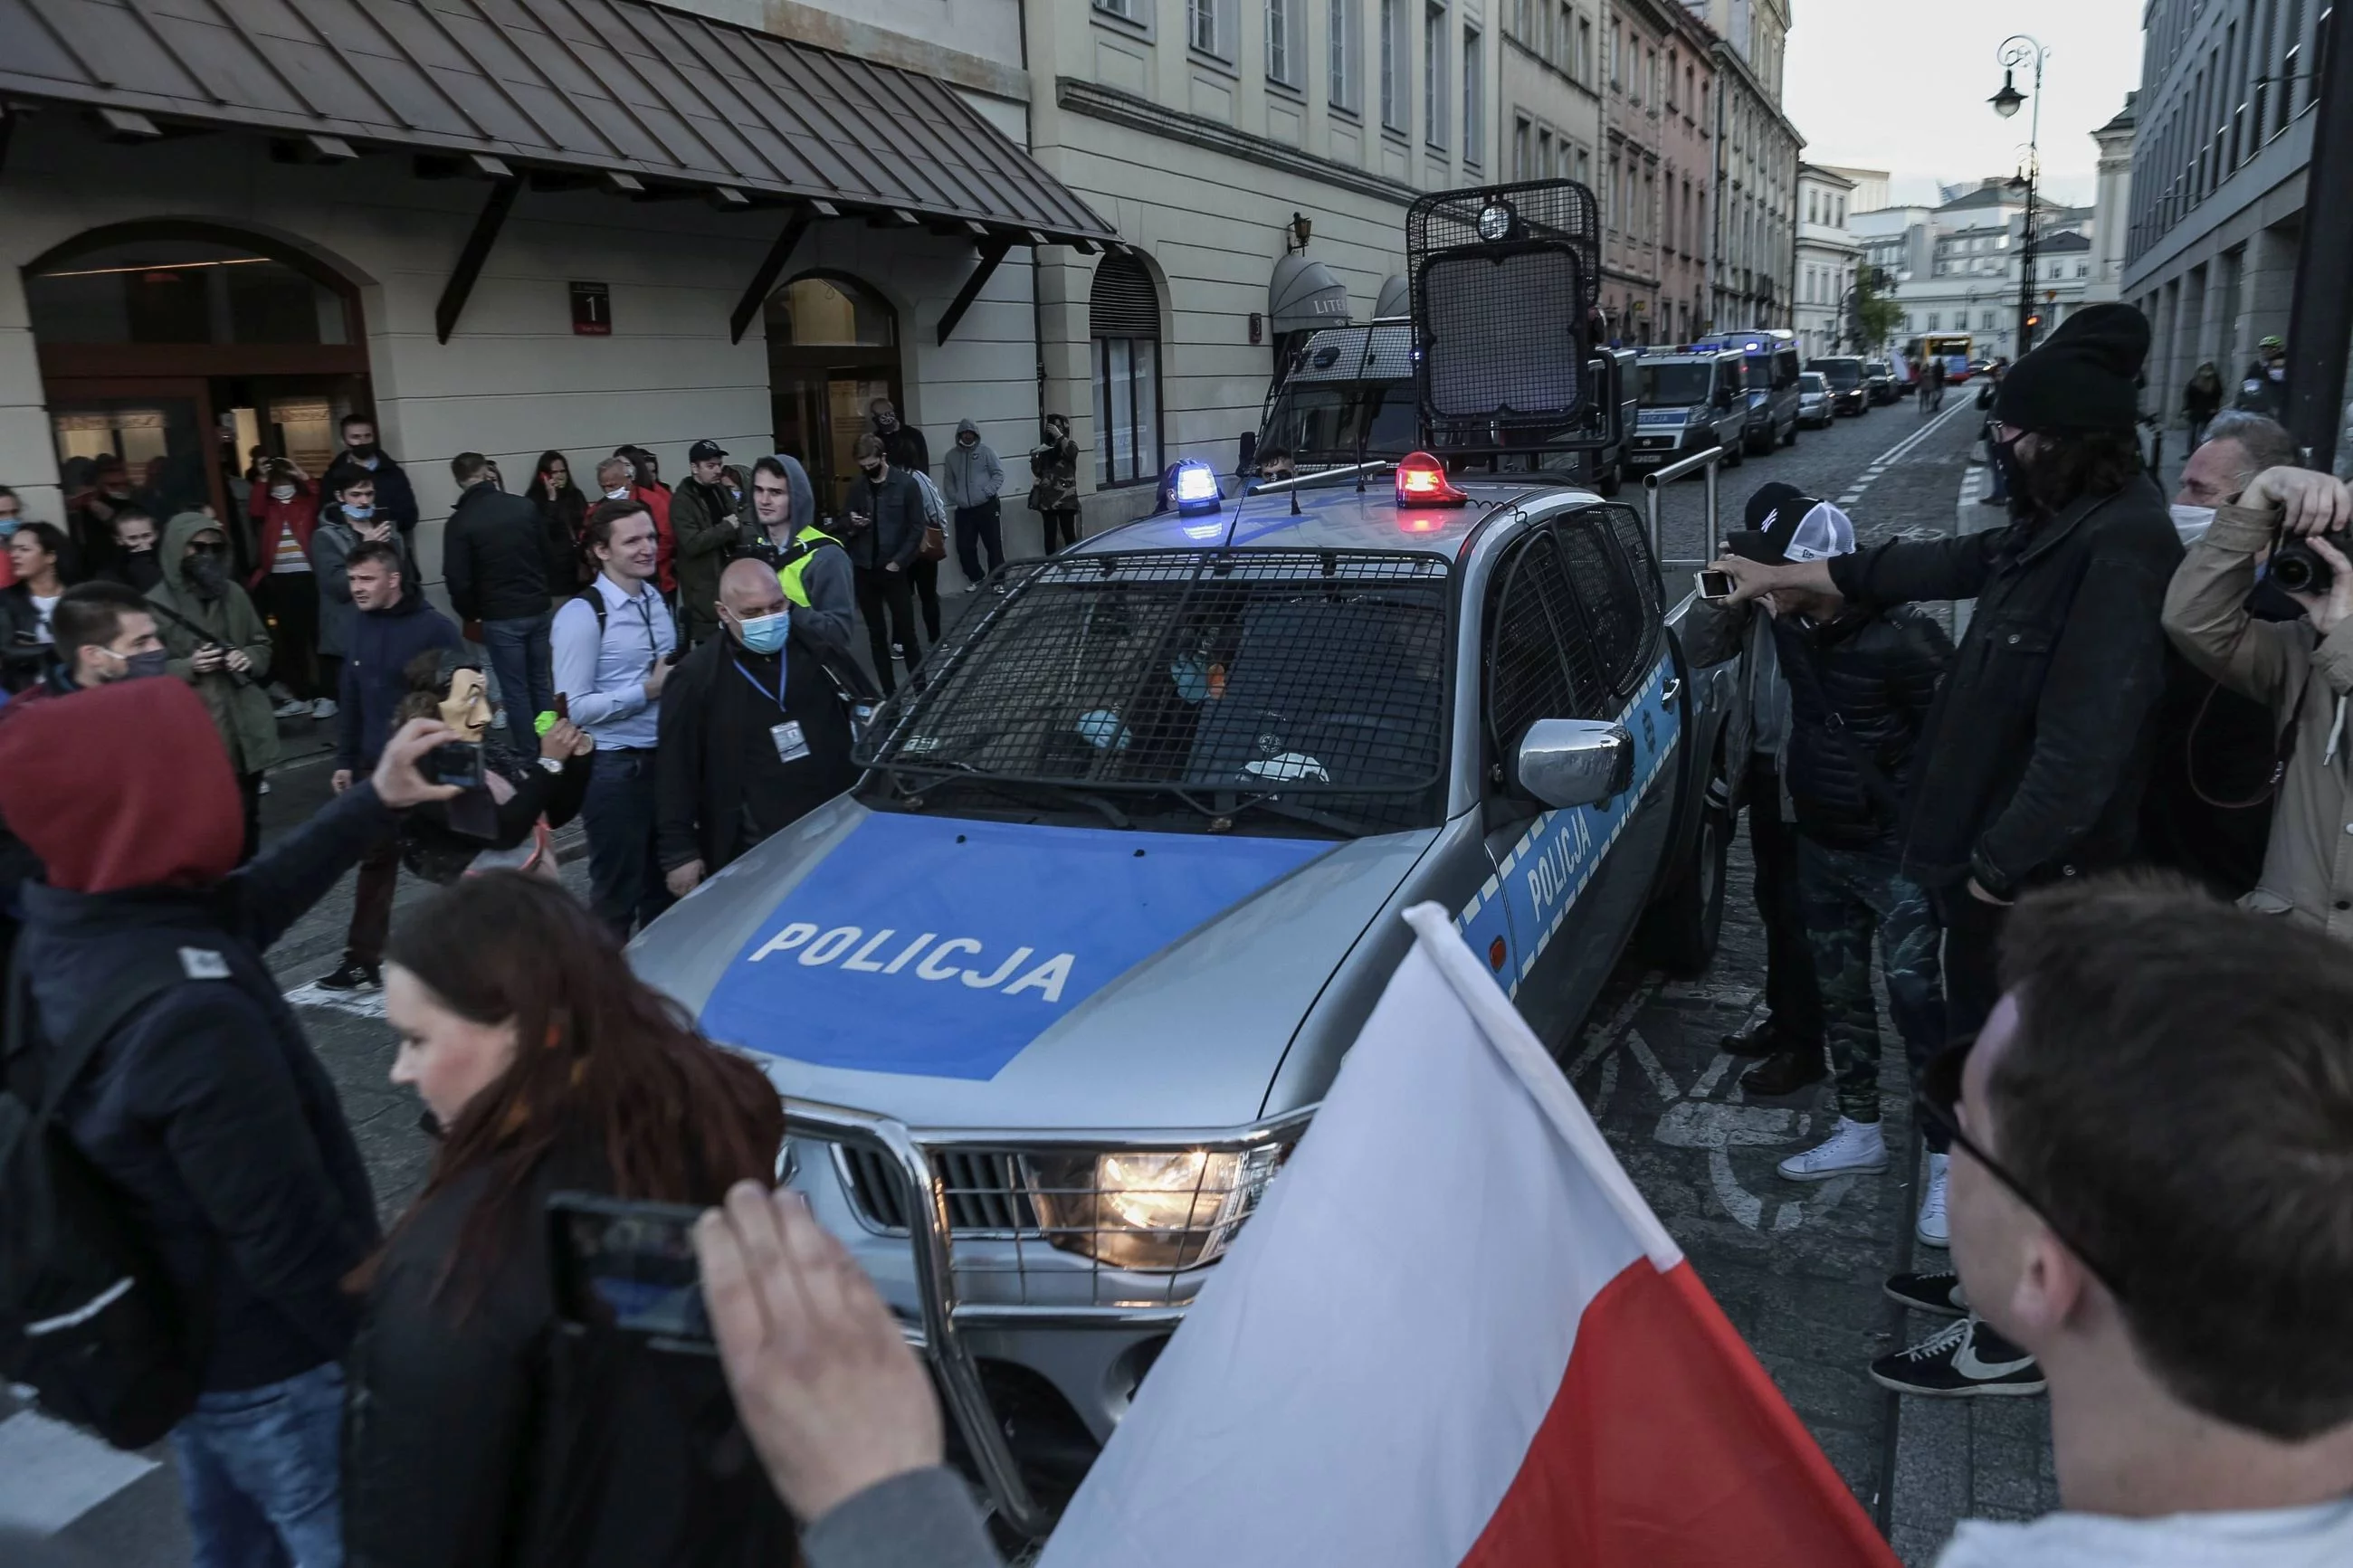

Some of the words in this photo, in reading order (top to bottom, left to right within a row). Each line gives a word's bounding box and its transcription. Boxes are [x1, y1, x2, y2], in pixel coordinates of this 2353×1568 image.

[586, 296, 596, 322] 1
[1313, 299, 1346, 314] LITE
[1527, 806, 1592, 923] POLICJA
[748, 922, 1076, 1003] POLICJA
